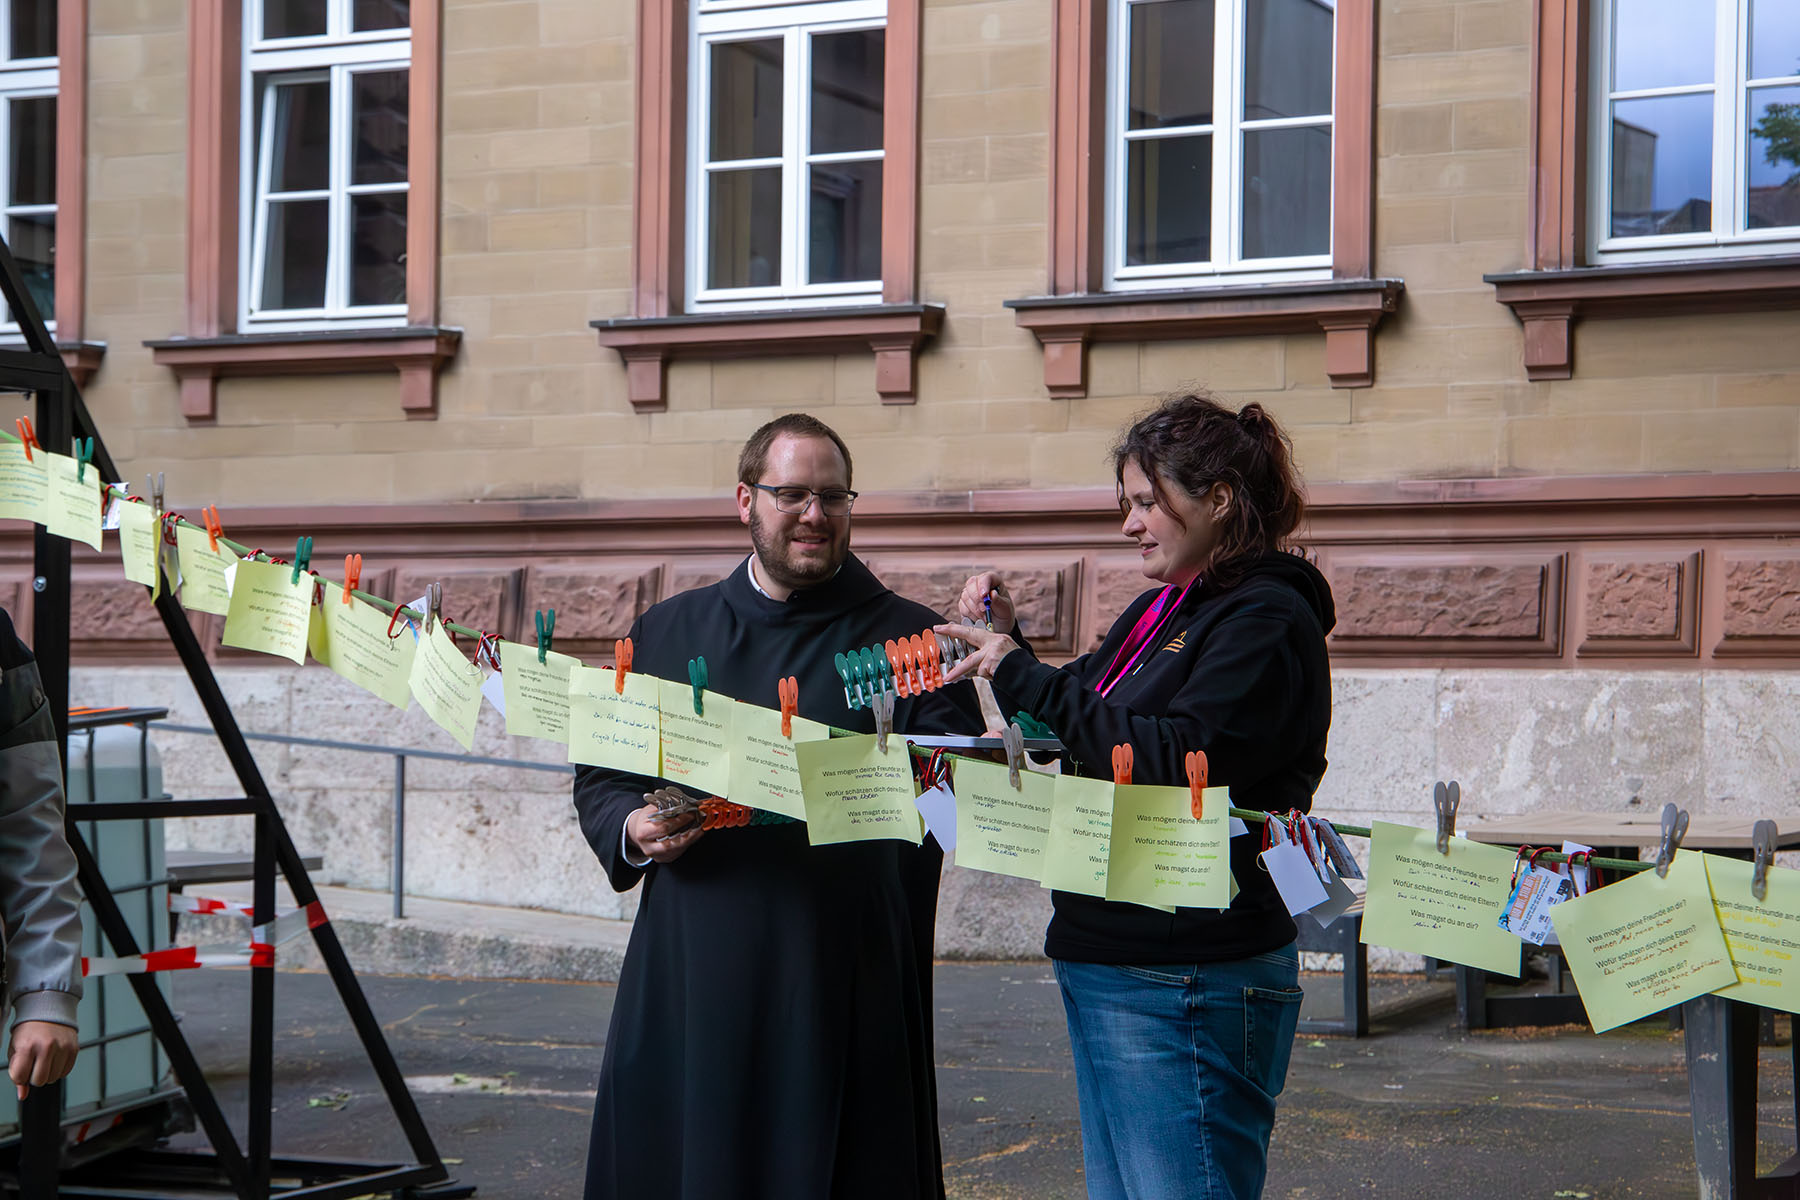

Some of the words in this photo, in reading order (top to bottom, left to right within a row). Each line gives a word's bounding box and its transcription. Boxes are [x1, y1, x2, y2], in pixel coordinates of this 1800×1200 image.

[837, 768, 858, 776] mögen
[845, 786, 873, 795] schätzen
[1075, 806, 1088, 814] Was
[1089, 807, 1110, 817] mögen
[1152, 815, 1177, 824] mögen
[1073, 828, 1091, 837] Wofür
[1157, 838, 1187, 847] schätzen
[1089, 855, 1102, 864] Was
[1170, 865, 1190, 873] magst
[1395, 854, 1411, 864] Was
[1411, 858, 1433, 869] mögen
[1434, 863, 1451, 872] deine
[1452, 866, 1478, 879] Freunde
[1487, 874, 1499, 884] dir?
[1393, 878, 1413, 888] Wofür
[1414, 882, 1443, 895] schätzen
[1444, 889, 1458, 899] dich
[1459, 893, 1476, 903] deine
[1477, 896, 1499, 908] Eltern?
[1733, 902, 1753, 912] deine
[1755, 906, 1784, 918] Freunde
[1785, 912, 1794, 920] an
[1410, 909, 1426, 918] Was
[1426, 913, 1446, 924] magst
[1447, 917, 1455, 925] du
[1466, 921, 1479, 930] dir?
[1586, 934, 1604, 945] Was
[1604, 925, 1627, 937] mögen
[1626, 919, 1643, 930] deine
[1643, 909, 1667, 923] Freunde
[1666, 905, 1675, 913] an
[1675, 899, 1687, 910] dir?
[1744, 931, 1760, 940] dich
[1760, 935, 1781, 945] deine
[1595, 957, 1617, 969] Wofür
[1618, 946, 1645, 961] schätzen
[1645, 940, 1658, 951] dich
[1658, 935, 1674, 945] deine
[1674, 924, 1697, 939] Eltern?
[1625, 979, 1641, 989] Was
[1640, 972, 1658, 984] magst
[1658, 969, 1667, 977] du
[1668, 965, 1675, 973] an
[1675, 959, 1688, 970] dir?
[1747, 961, 1757, 970] du
[1757, 964, 1767, 973] an
[1767, 966, 1783, 976] dir?
